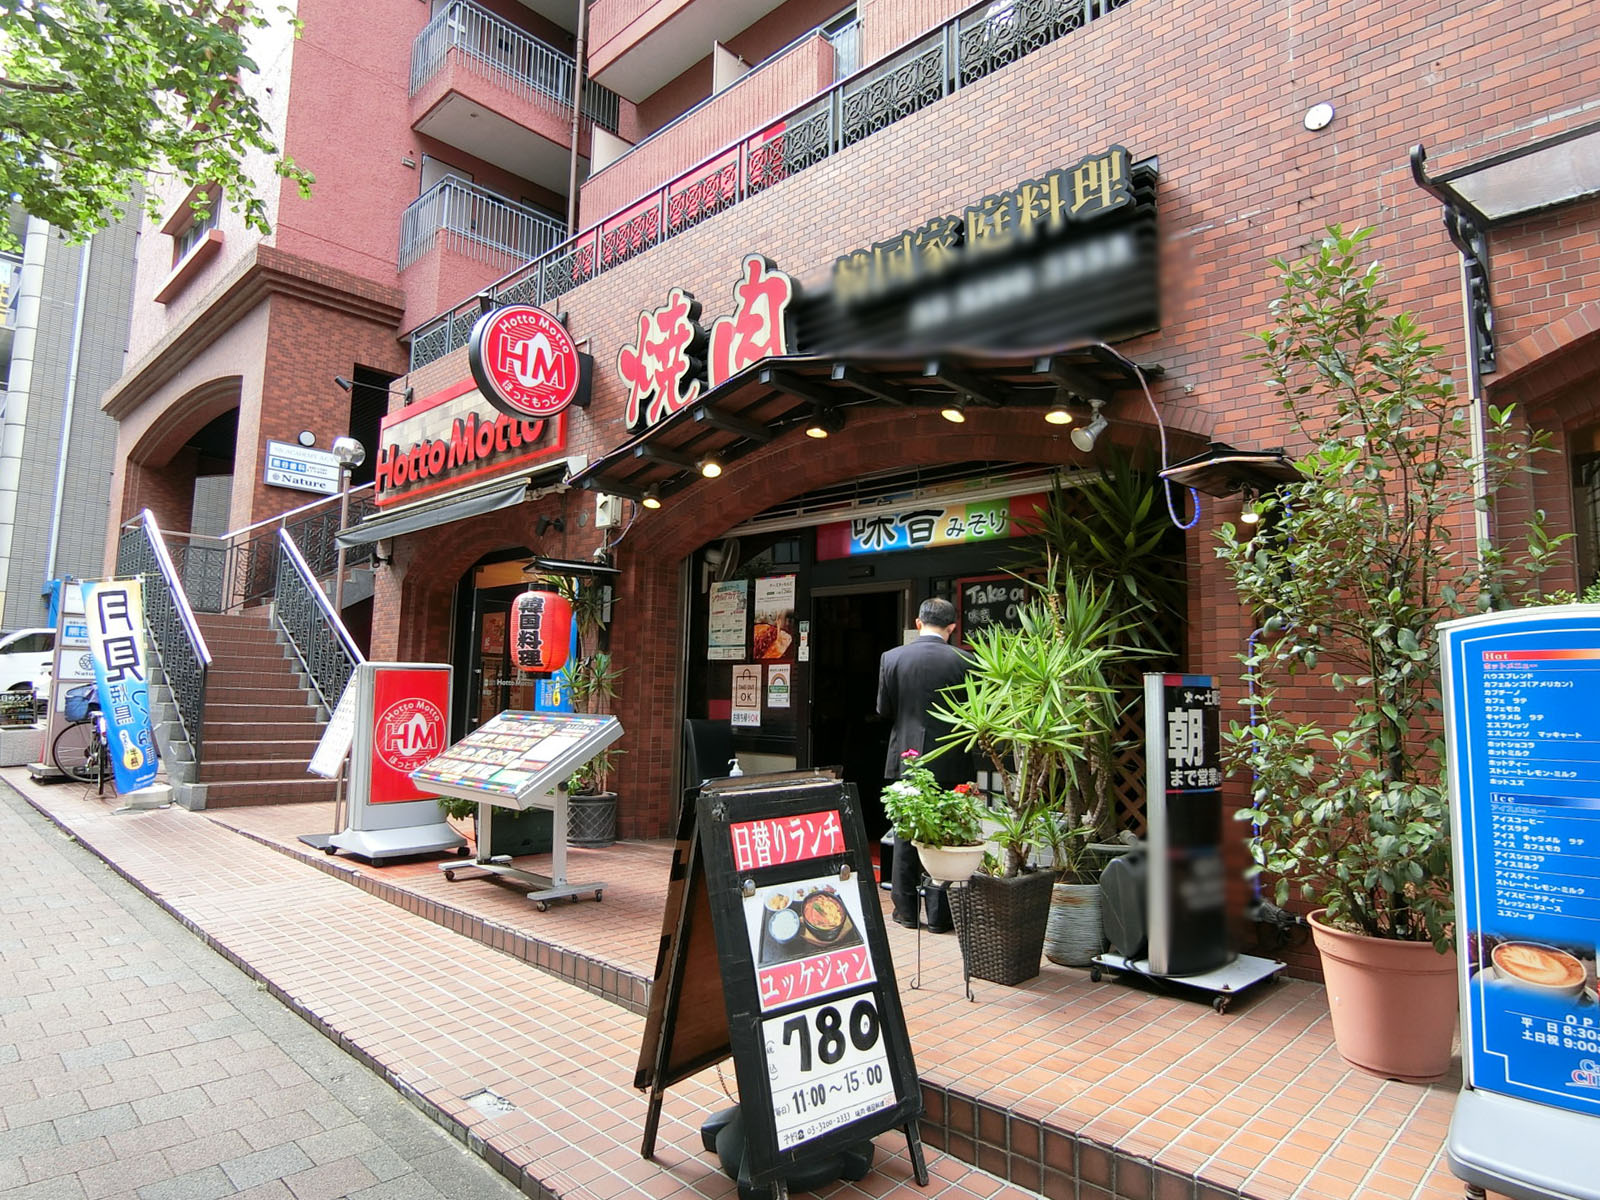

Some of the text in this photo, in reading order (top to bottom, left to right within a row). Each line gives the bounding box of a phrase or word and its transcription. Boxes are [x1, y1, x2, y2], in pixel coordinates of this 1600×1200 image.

[499, 315, 569, 353] Hotto Motto
[619, 256, 793, 429] 焼肉
[502, 380, 559, 408] ほっともっと
[375, 411, 546, 492] Hotto Motto
[282, 474, 326, 489] Nature
[966, 584, 1007, 604] Take
[517, 596, 545, 667] 韓国料理
[741, 693, 752, 701] OK
[384, 701, 440, 721] Hotto Motto
[1168, 707, 1204, 767] 朝
[1487, 741, 1535, 749] ホットショコラ
[1488, 749, 1530, 757] ホットミルク
[1494, 794, 1515, 803] Ice
[1491, 815, 1545, 825] アイスコーヒー
[1492, 823, 1530, 832] アイスラテ
[733, 811, 840, 871] 日替りランチ
[1493, 832, 1515, 840] アイス
[1493, 840, 1561, 853] アイス カフェモカ
[1494, 851, 1545, 862] アイスショコラ
[1494, 859, 1540, 870] アイスミルク
[1495, 870, 1540, 880] アイスティー
[761, 953, 867, 1001] ユッケジャン
[782, 999, 880, 1072] 780
[1522, 1029, 1560, 1047] 土日祝
